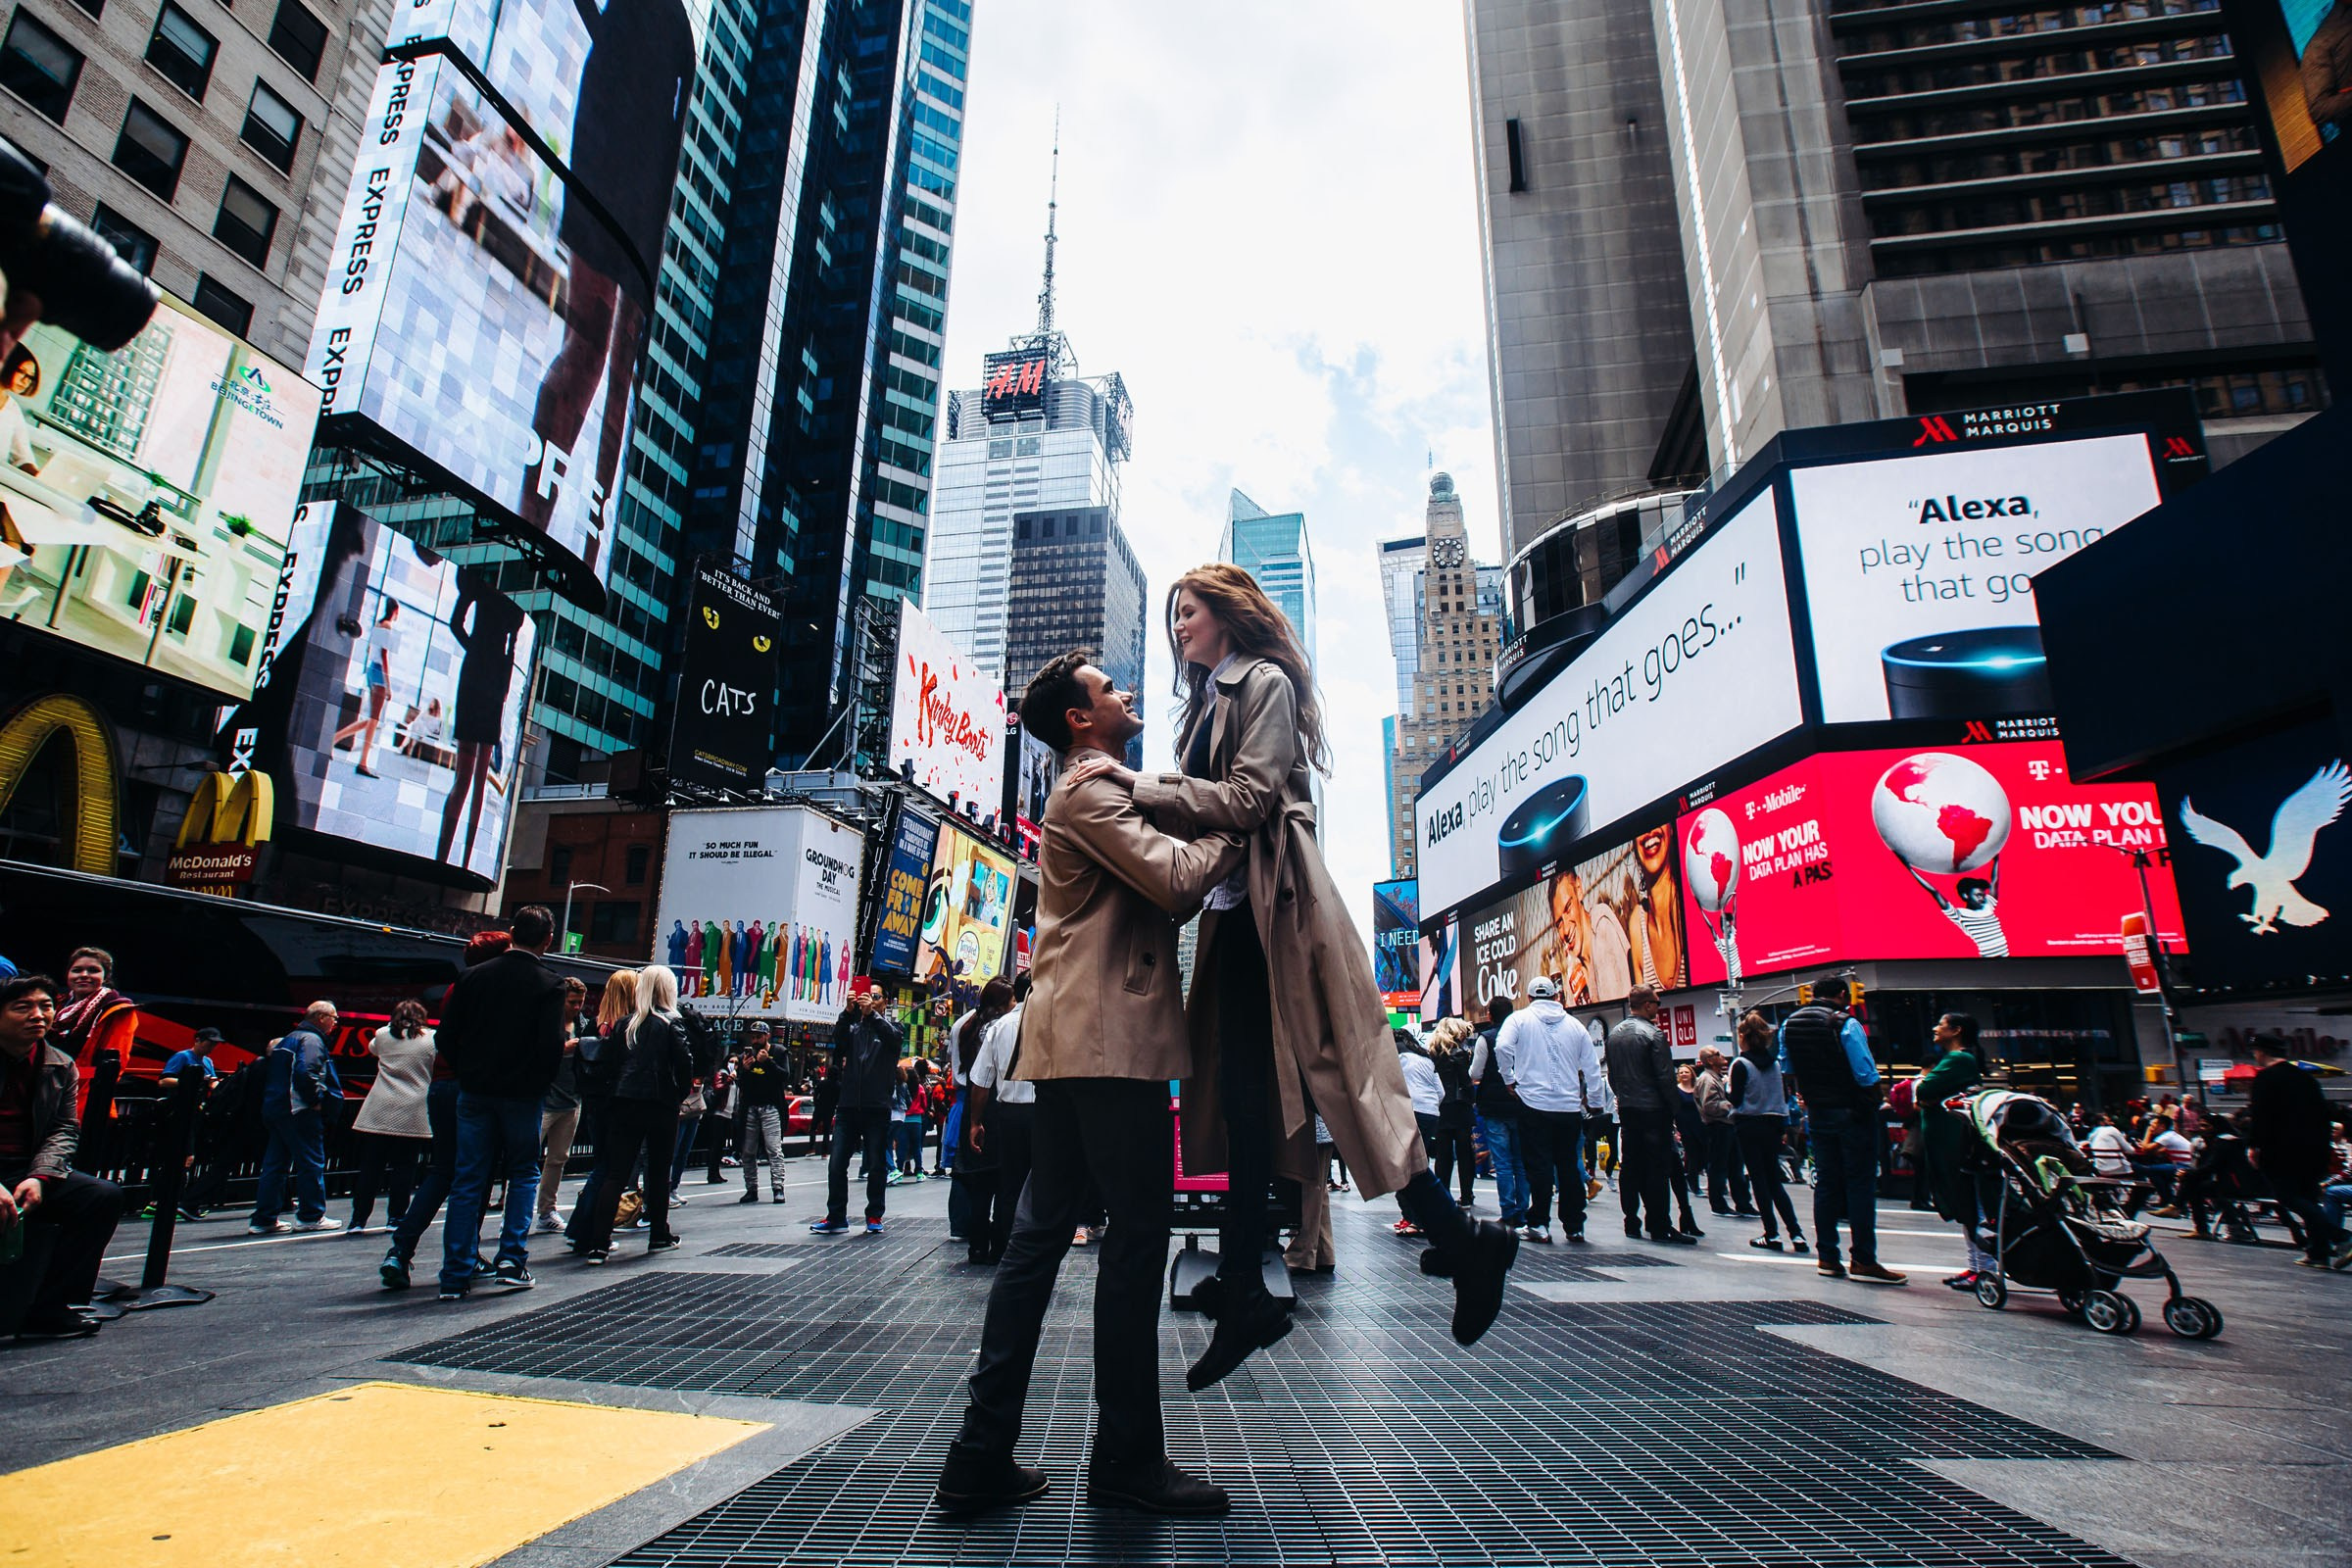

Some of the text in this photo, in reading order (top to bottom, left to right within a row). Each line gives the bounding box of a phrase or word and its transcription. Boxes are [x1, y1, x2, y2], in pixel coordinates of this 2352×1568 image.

[342, 167, 390, 296] EXPRESS
[985, 359, 1046, 400] H&M
[210, 380, 284, 429] BEIJINGETOWN
[1963, 404, 2062, 424] MARRIOTT
[1965, 418, 2054, 439] MARQUIS
[1669, 506, 1708, 547] MARRIOTT
[1670, 521, 1706, 558] MARQUIS
[1859, 538, 1931, 575] play
[1942, 531, 2003, 562] the
[714, 569, 731, 584] IT'S
[731, 578, 753, 596] BACK
[753, 591, 770, 606] AND
[733, 589, 758, 608] THAN
[1898, 572, 1976, 603] that
[701, 679, 757, 717] CATS
[917, 662, 989, 762] Kinky Boots
[1006, 727, 1017, 736] LG
[1469, 774, 1496, 829] play
[1500, 751, 1528, 794] the
[1533, 709, 1581, 771] song
[1585, 660, 1638, 730] that
[1997, 727, 2060, 739] MARQUIS
[1689, 781, 1716, 800] MARRIOTT
[1690, 792, 1714, 808] MARQUIS
[2019, 804, 2092, 830] NOW
[719, 841, 742, 850] MUCH
[1742, 819, 1821, 865] NOW YOUR
[2034, 830, 2088, 850] DATA
[2092, 828, 2152, 847] PLAN
[169, 854, 252, 869] McDonald's
[699, 851, 729, 859] SHOULD
[806, 848, 855, 879] GROUNDHOG
[1749, 841, 1829, 881] DATA PLAN HAS
[179, 869, 235, 879] Restaurant
[822, 868, 837, 886] DAY
[868, 847, 883, 897] MAC
[891, 868, 925, 900] COME
[1792, 870, 1803, 889] A
[824, 884, 841, 897] MUSICAL
[858, 902, 872, 952] MAC
[881, 909, 918, 938] AWAY
[1475, 912, 1514, 943] SHARE AN
[1380, 932, 1386, 948] I
[1476, 935, 1516, 965] ICE COLD
[1677, 1010, 1691, 1025] UNI
[1678, 1028, 1694, 1042] QLO
